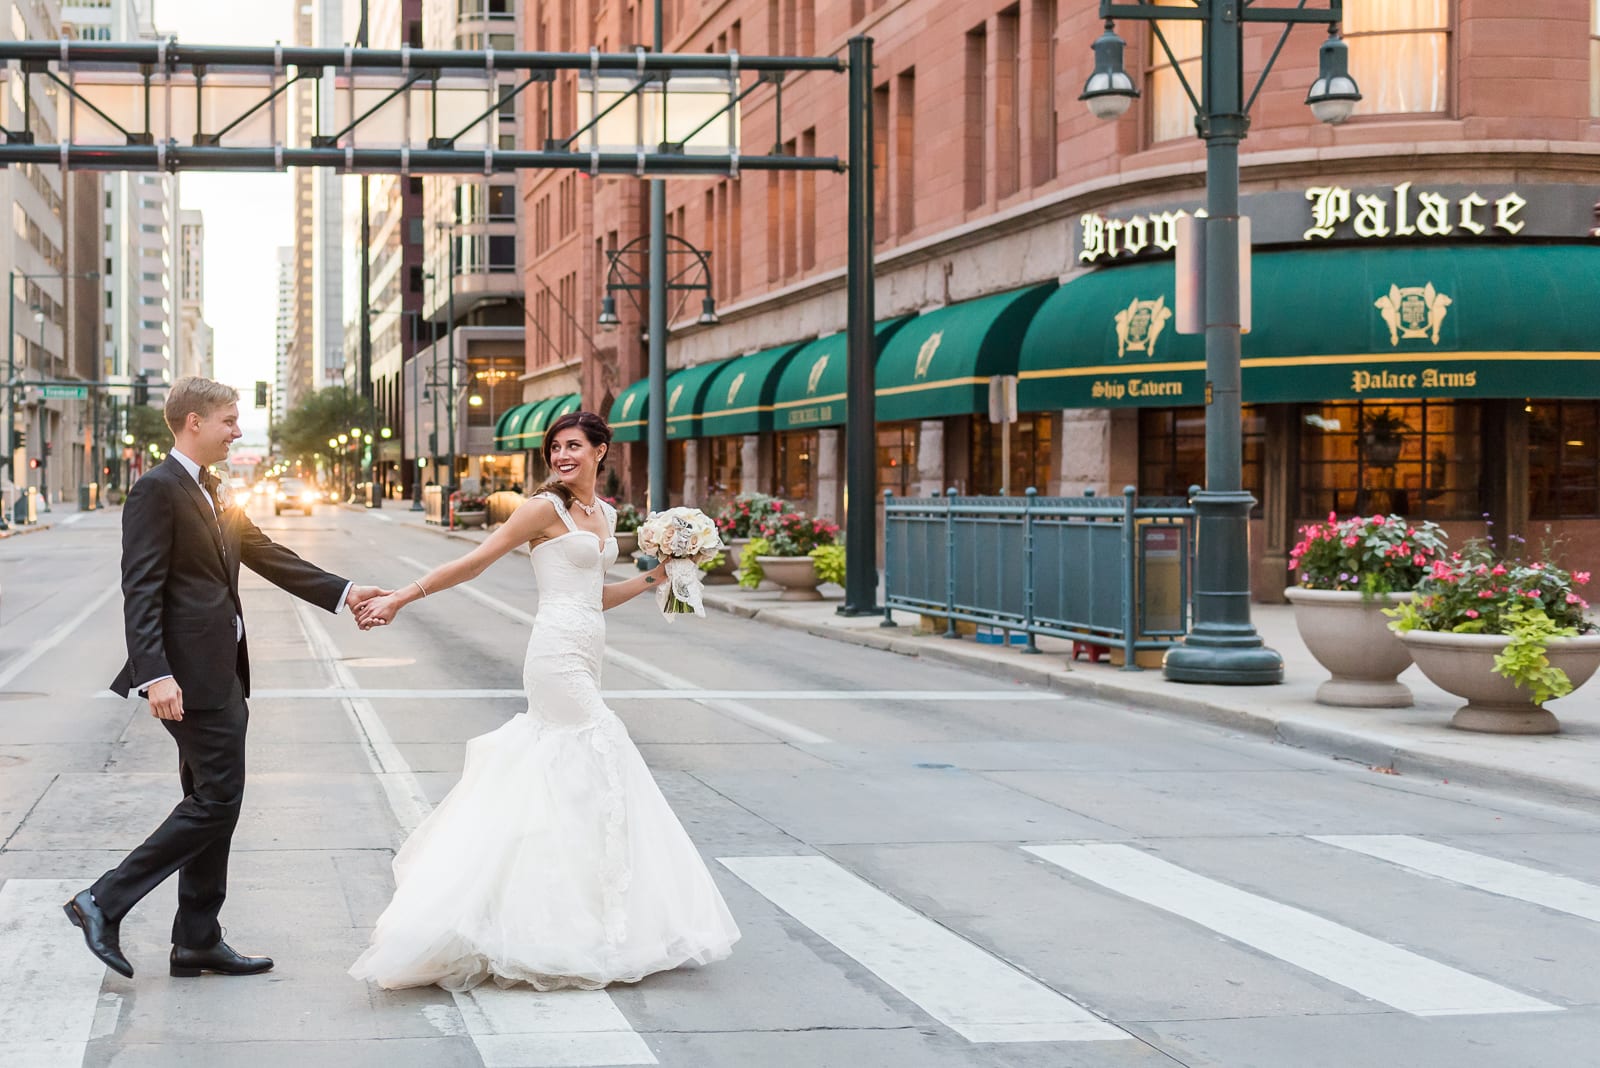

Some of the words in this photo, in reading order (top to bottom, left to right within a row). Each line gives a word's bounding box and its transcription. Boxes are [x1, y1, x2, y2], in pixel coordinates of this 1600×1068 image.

[1079, 208, 1209, 262] Brow
[1303, 181, 1527, 241] Palace
[1092, 380, 1125, 399] Ship
[1127, 379, 1183, 397] Tavern
[1351, 369, 1417, 392] Palace
[1421, 368, 1477, 388] Arms
